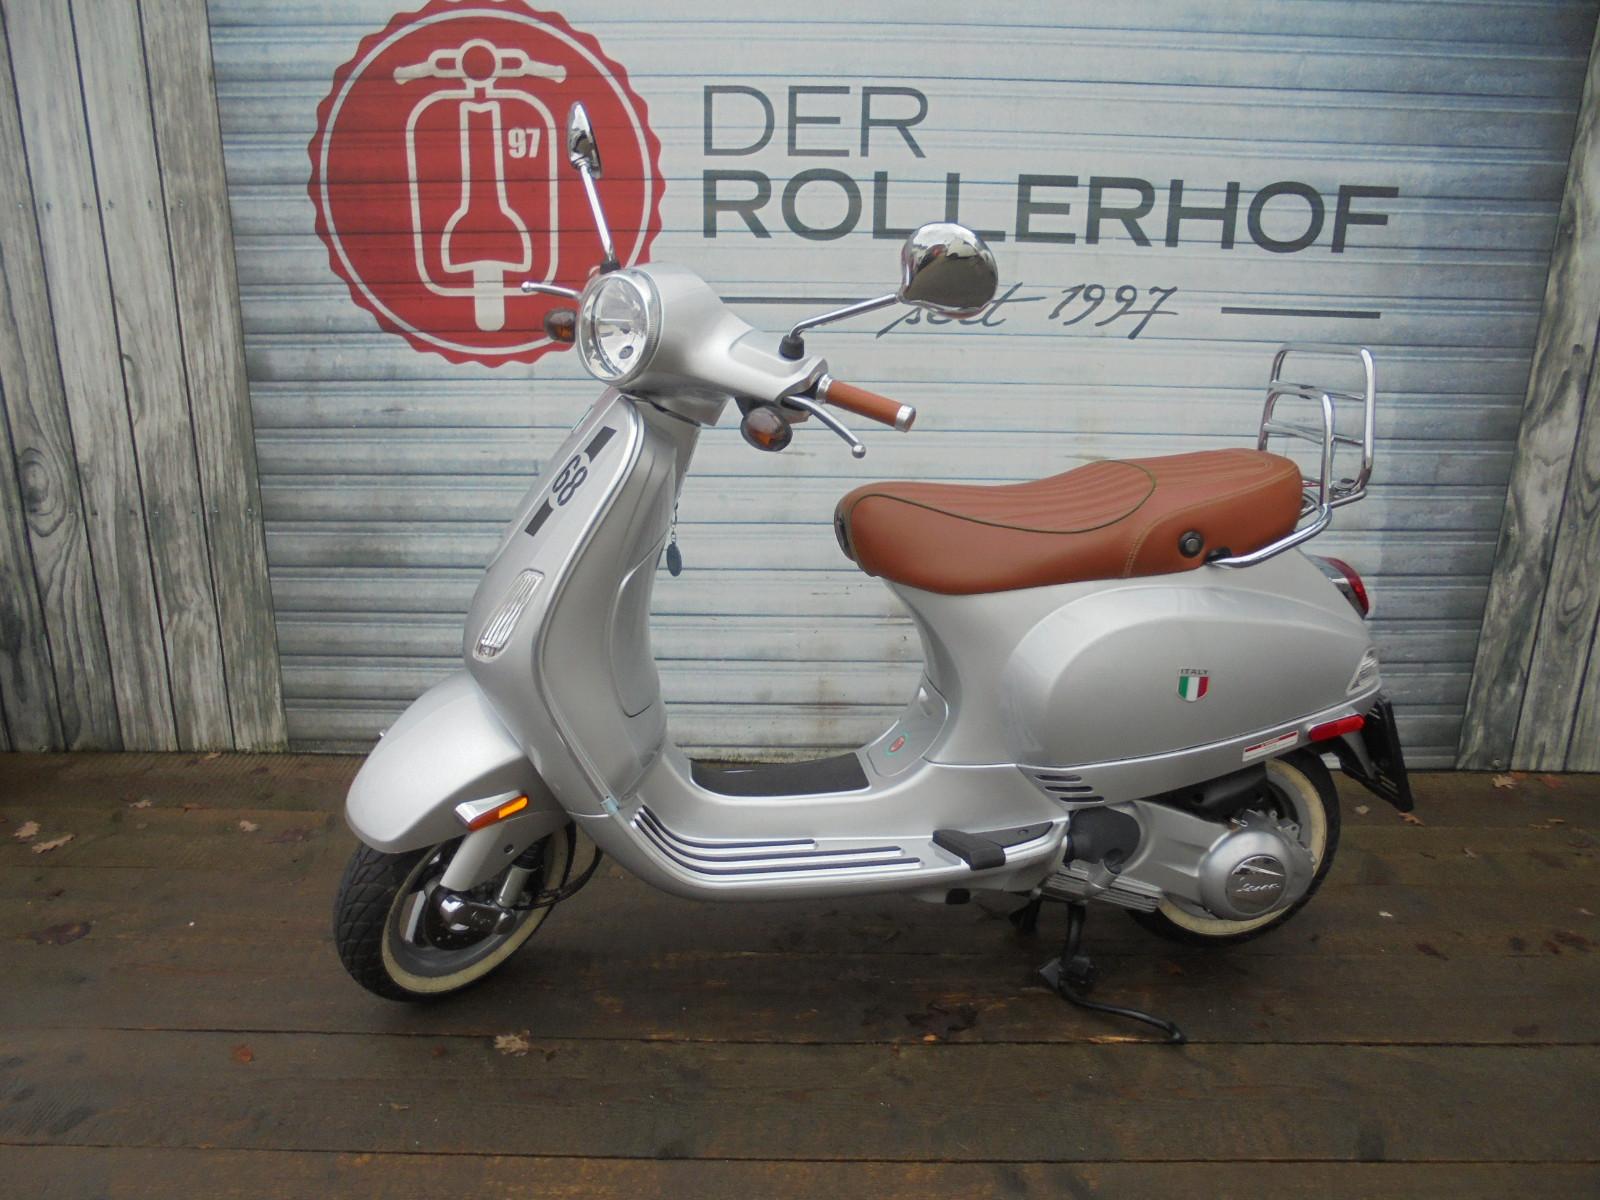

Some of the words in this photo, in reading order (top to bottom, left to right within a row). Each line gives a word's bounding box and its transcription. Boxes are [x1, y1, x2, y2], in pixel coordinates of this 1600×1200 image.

[508, 127, 541, 158] 97
[703, 85, 928, 158] DER
[702, 168, 1399, 253] ROLLERHOF
[876, 282, 1046, 339] set
[1048, 283, 1178, 339] 1997
[552, 454, 588, 506] 68
